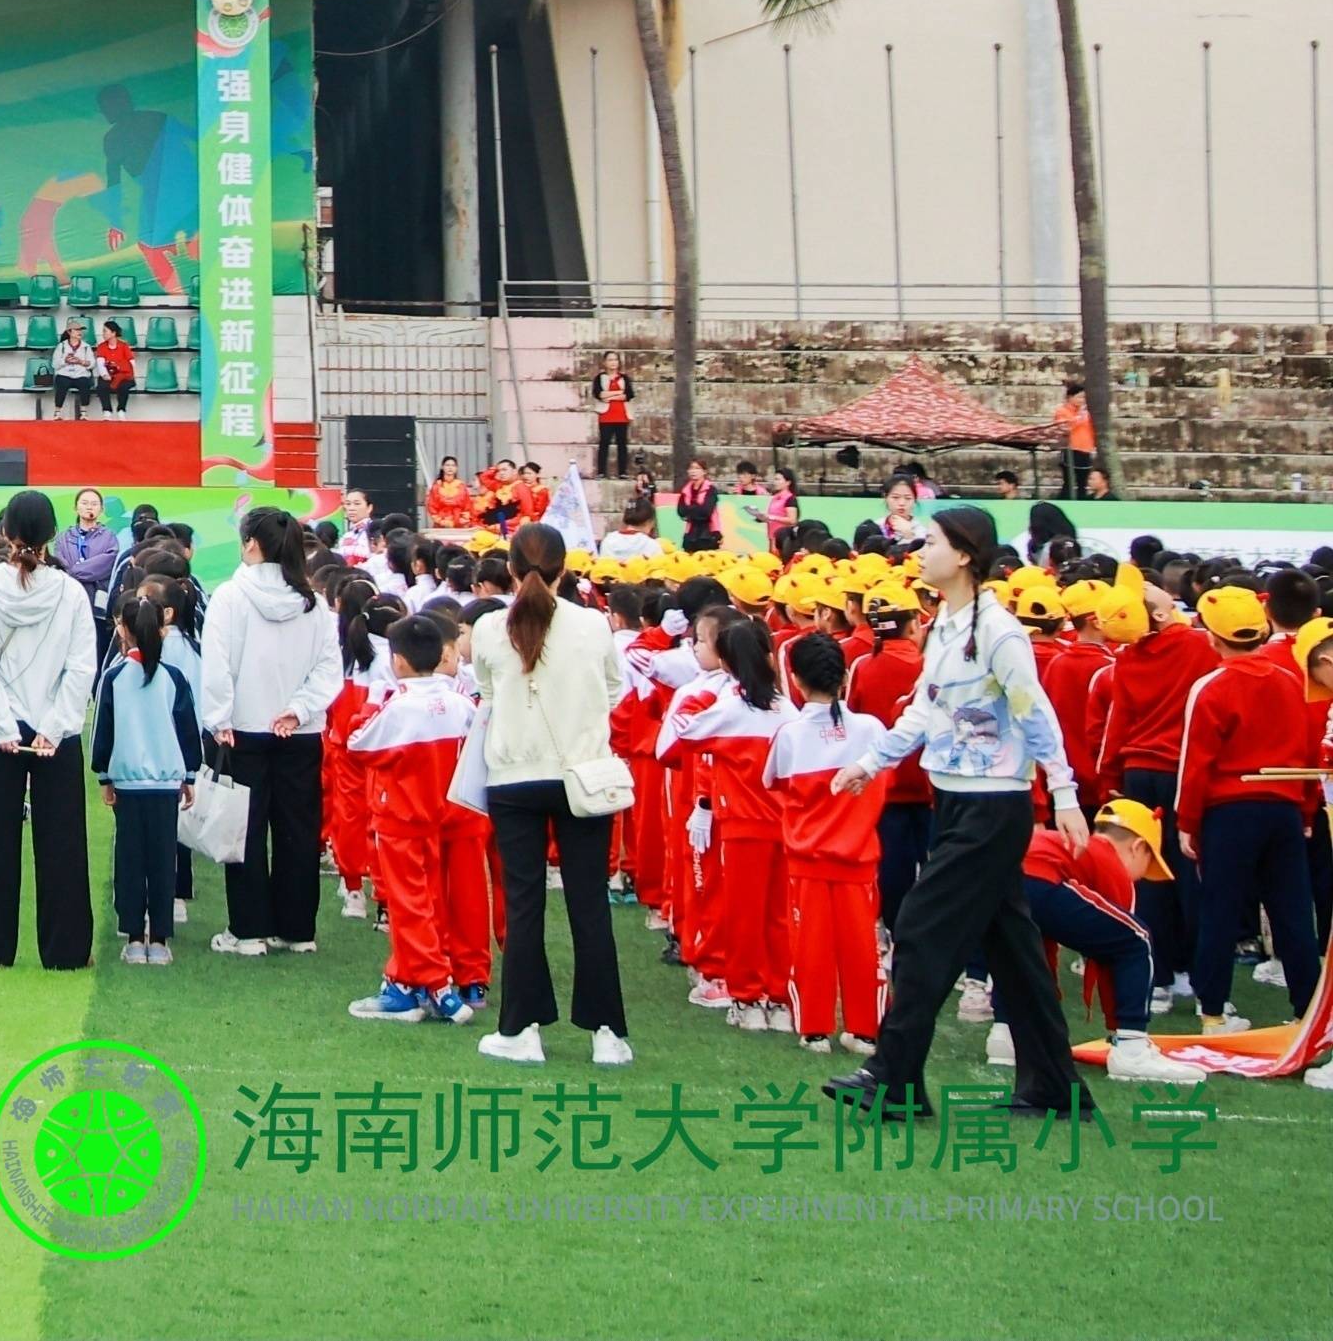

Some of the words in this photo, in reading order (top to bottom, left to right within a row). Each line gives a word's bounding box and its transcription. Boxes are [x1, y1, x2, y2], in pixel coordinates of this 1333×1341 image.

[217, 69, 256, 437] 强身健体奋进新征程
